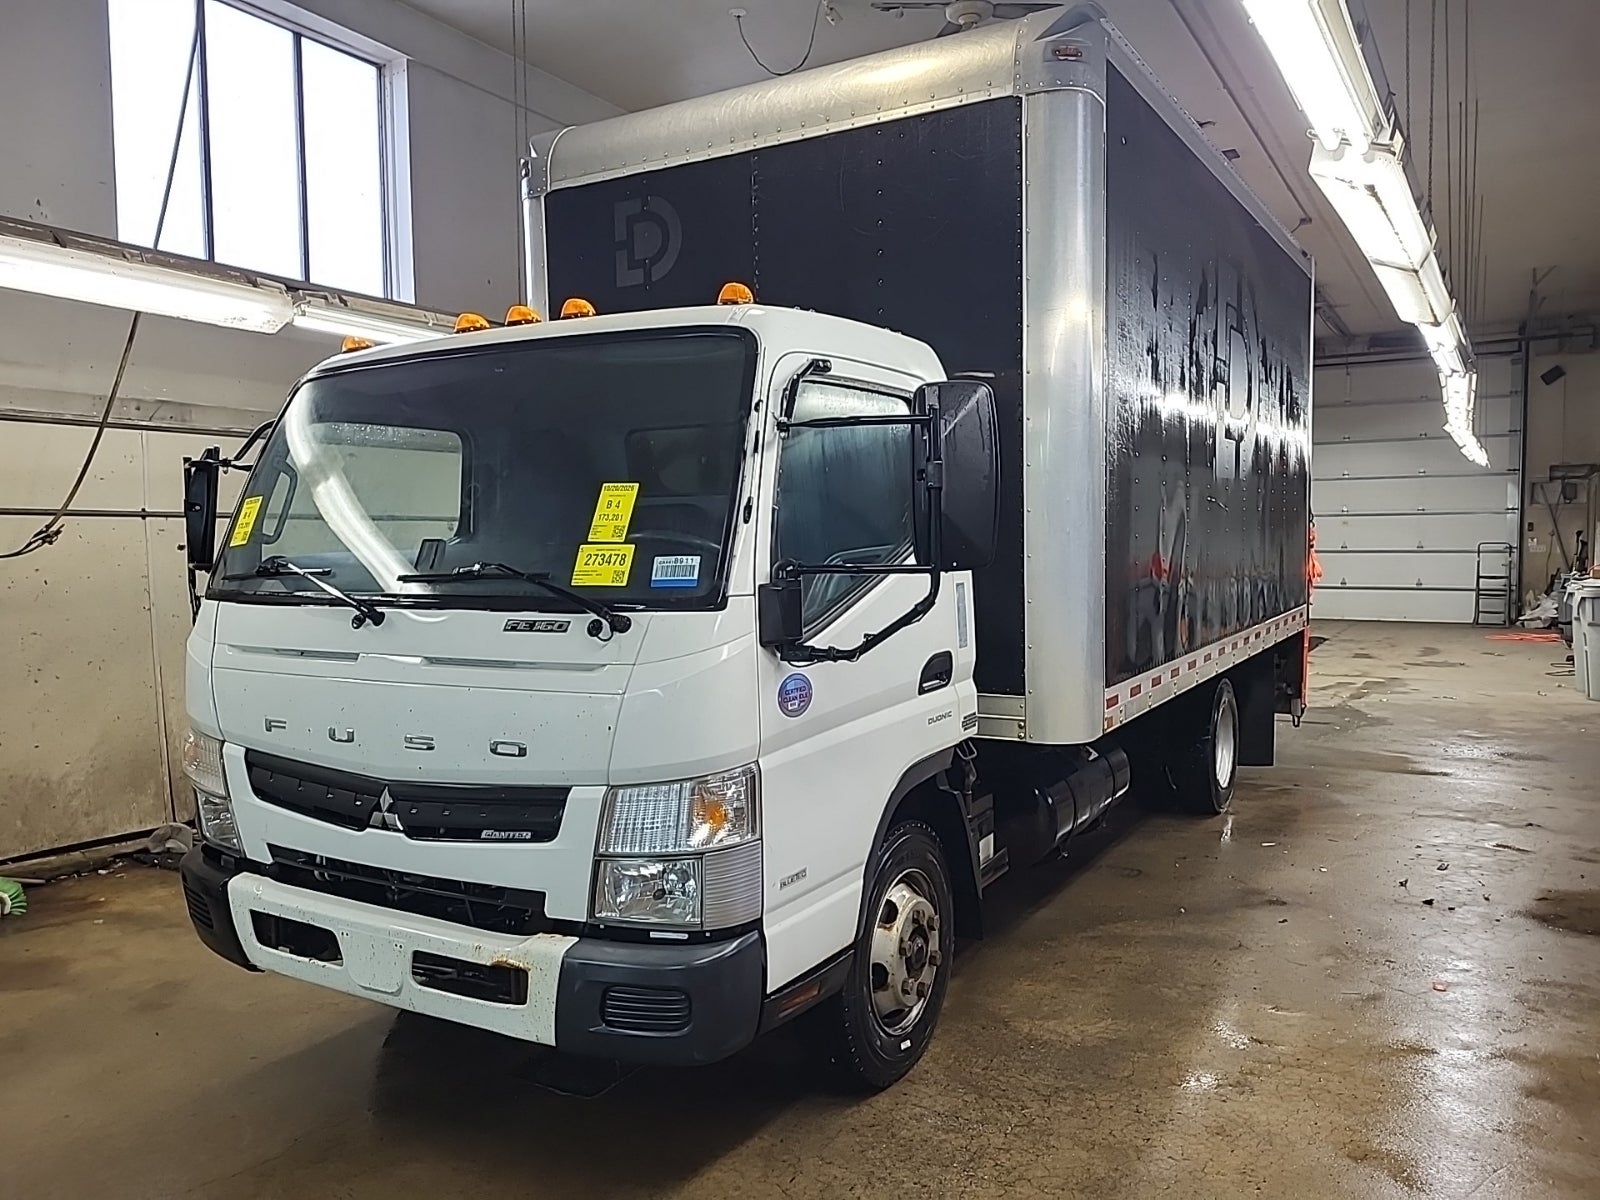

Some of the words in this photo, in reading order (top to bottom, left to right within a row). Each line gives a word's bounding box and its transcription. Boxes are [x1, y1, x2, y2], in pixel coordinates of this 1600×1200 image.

[606, 499, 613, 509] B
[614, 499, 621, 509] 4
[584, 553, 627, 566] 273478
[784, 685, 807, 696] CERTIFIED
[783, 694, 798, 704] CLEAN
[798, 692, 809, 701] IDLE
[927, 710, 953, 725] DUONIC
[264, 717, 528, 758] FUSO
[480, 829, 532, 840] CANTER
